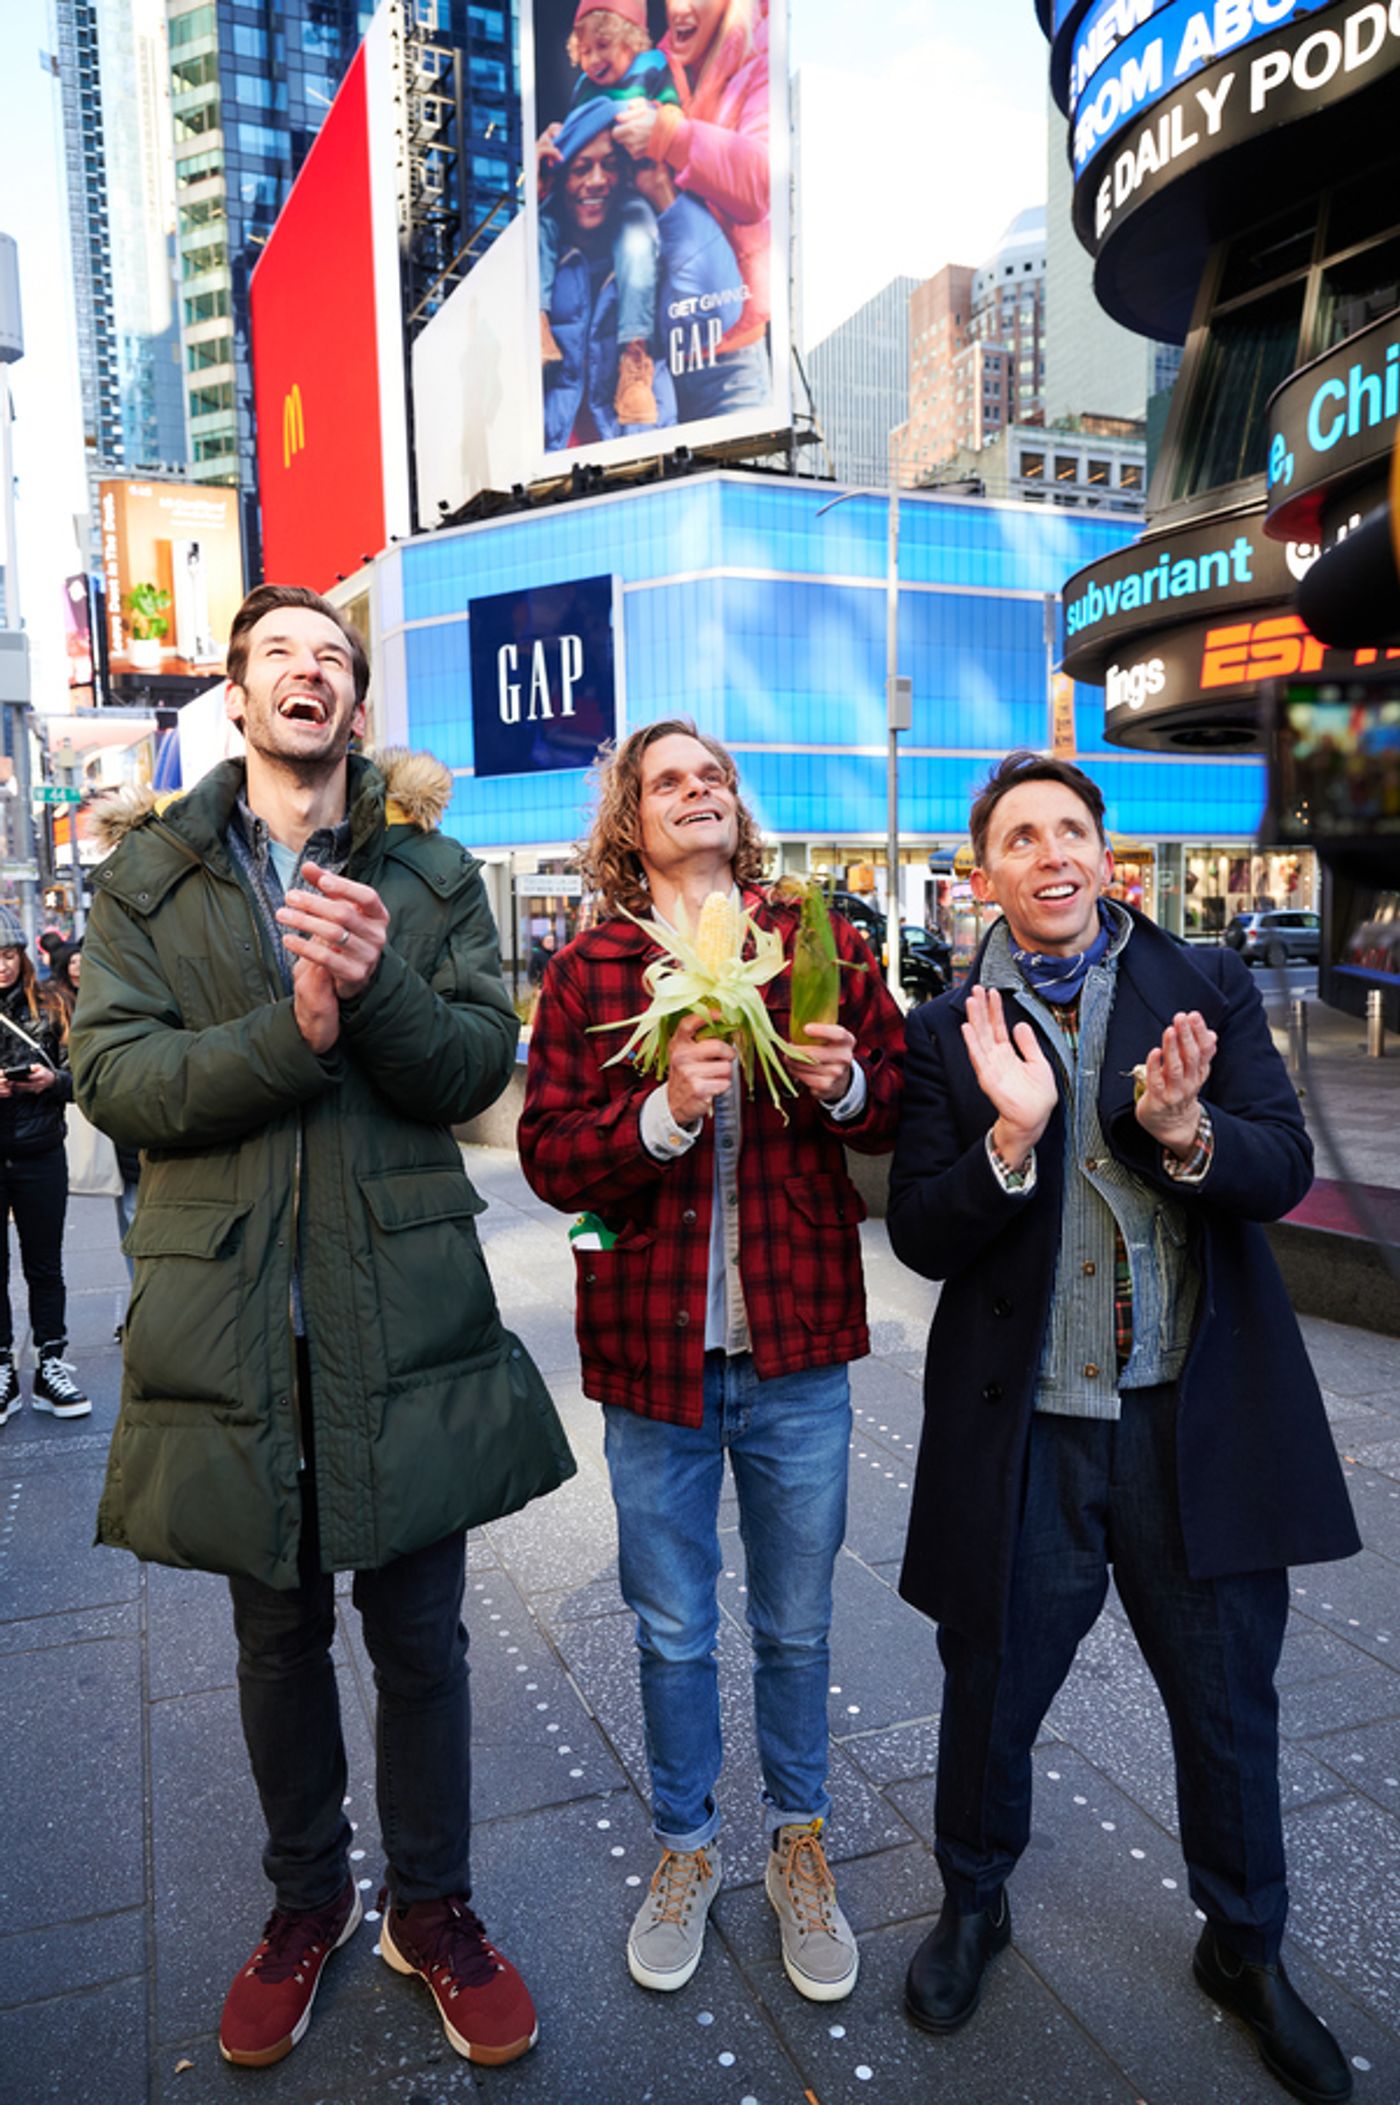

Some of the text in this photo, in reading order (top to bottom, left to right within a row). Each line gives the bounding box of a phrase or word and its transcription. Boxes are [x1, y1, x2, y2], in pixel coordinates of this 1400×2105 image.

[1074, 37, 1163, 164] ROM
[1114, 72, 1235, 209] DAILY
[668, 296, 699, 319] GET
[670, 317, 723, 376] GAP
[1307, 342, 1400, 452] Chi
[1066, 536, 1255, 637] subvariant
[498, 634, 583, 725] GAP
[1200, 614, 1400, 690] ES
